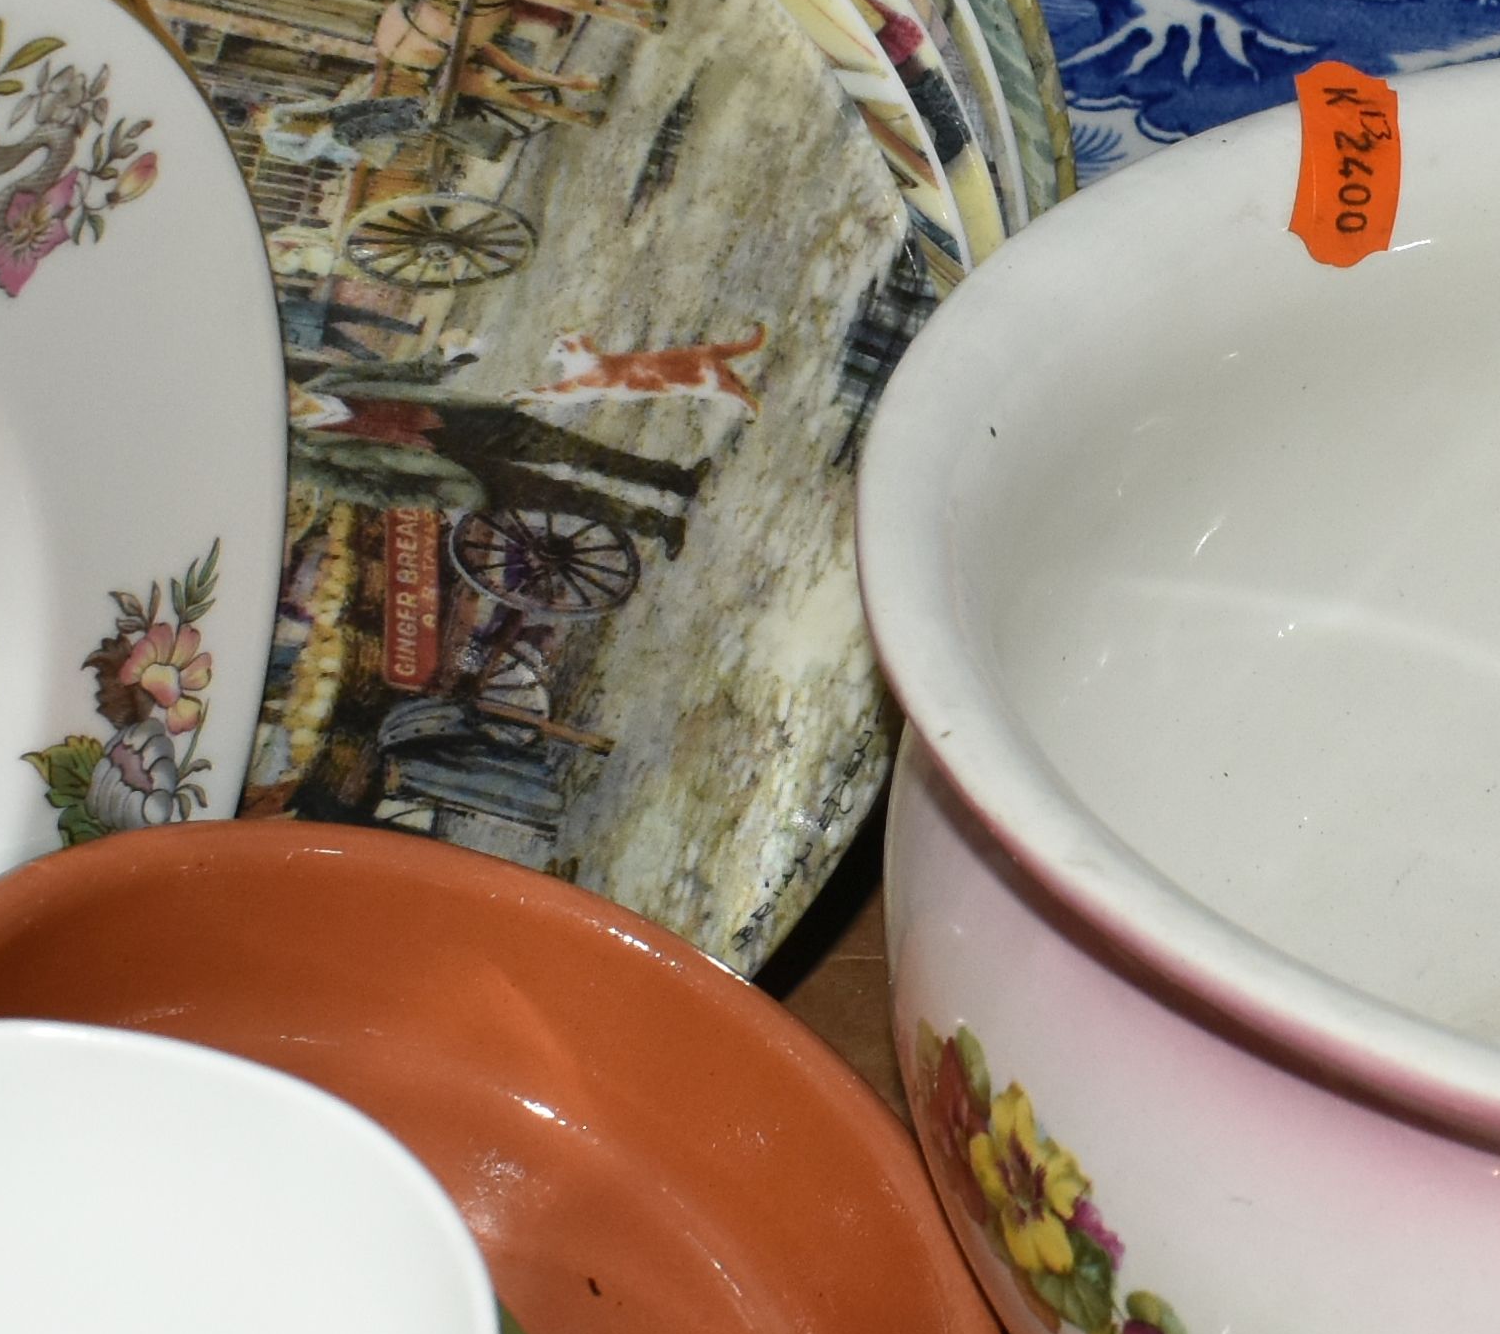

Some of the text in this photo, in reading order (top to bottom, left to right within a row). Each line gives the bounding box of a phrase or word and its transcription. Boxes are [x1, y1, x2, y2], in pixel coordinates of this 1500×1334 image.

[1322, 87, 1376, 234] K 2400
[394, 591, 419, 677] GINGER
